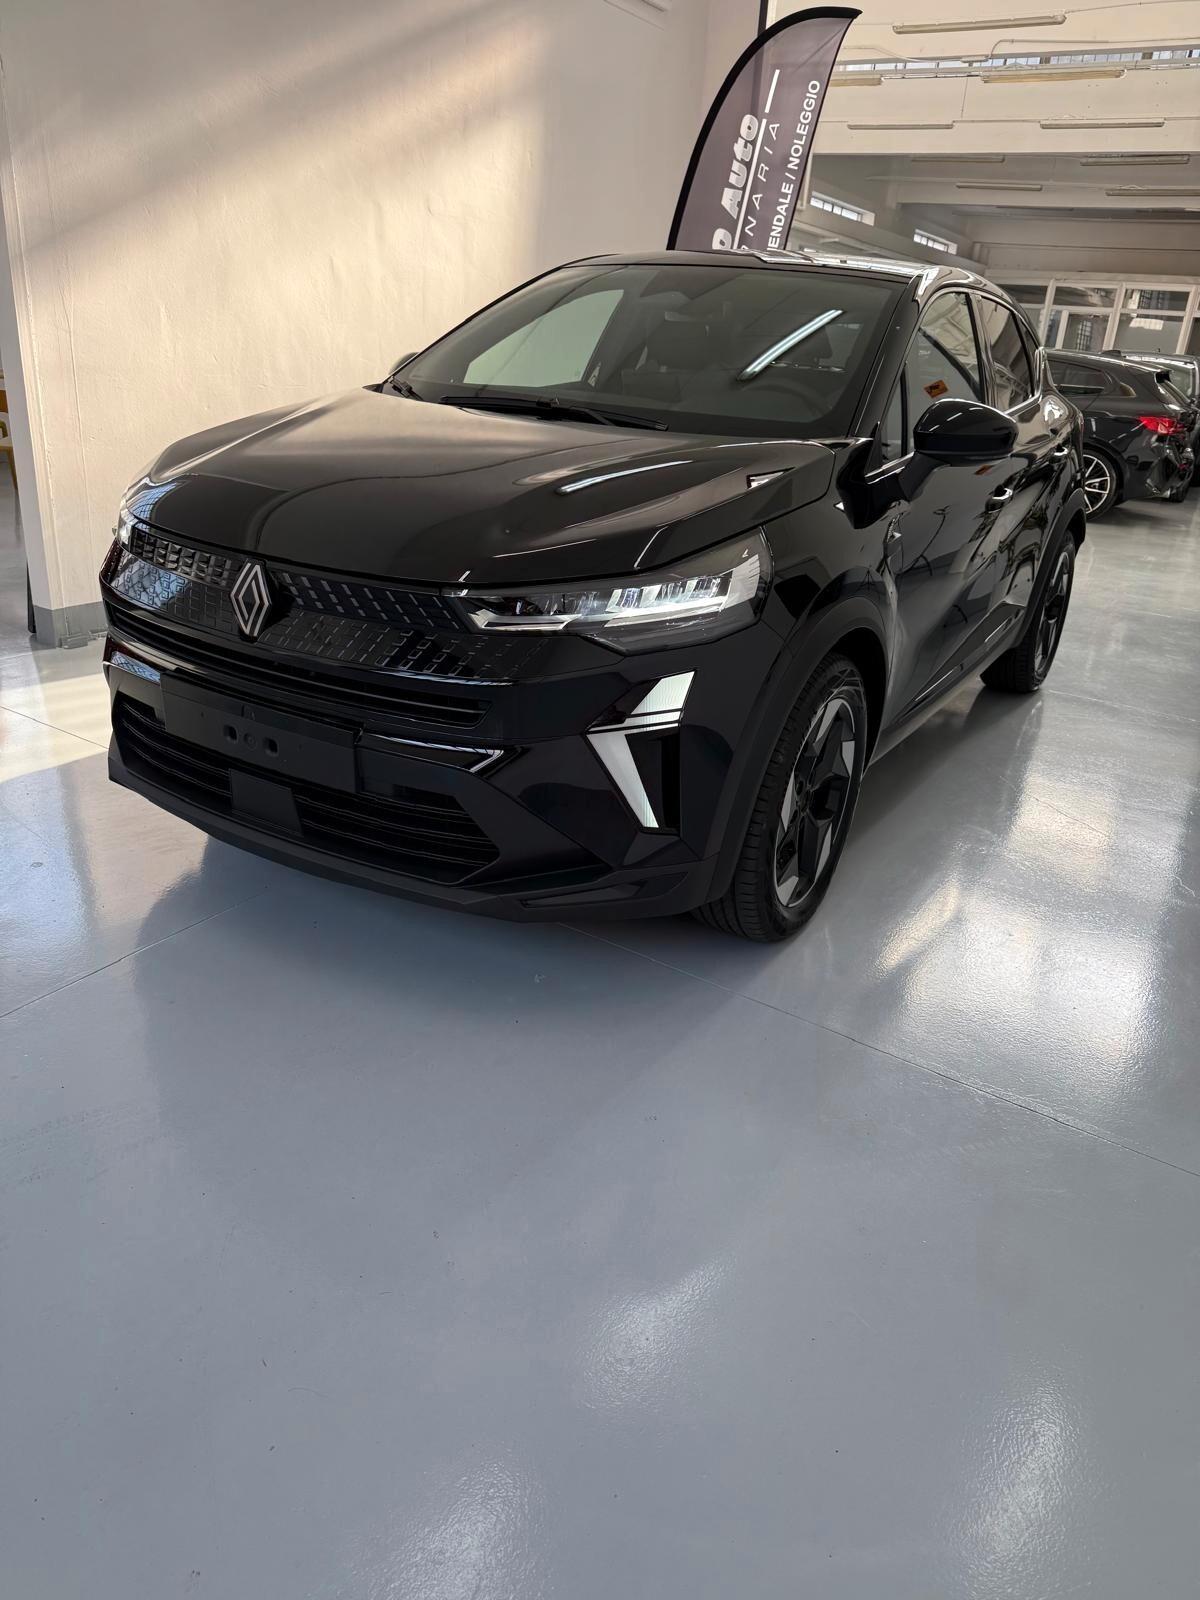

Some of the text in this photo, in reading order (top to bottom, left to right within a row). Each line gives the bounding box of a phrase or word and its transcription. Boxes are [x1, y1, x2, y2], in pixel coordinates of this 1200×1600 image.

[720, 114, 758, 219] Auto
[787, 80, 820, 170] NOLEGGIO
[741, 123, 780, 250] NARIA
